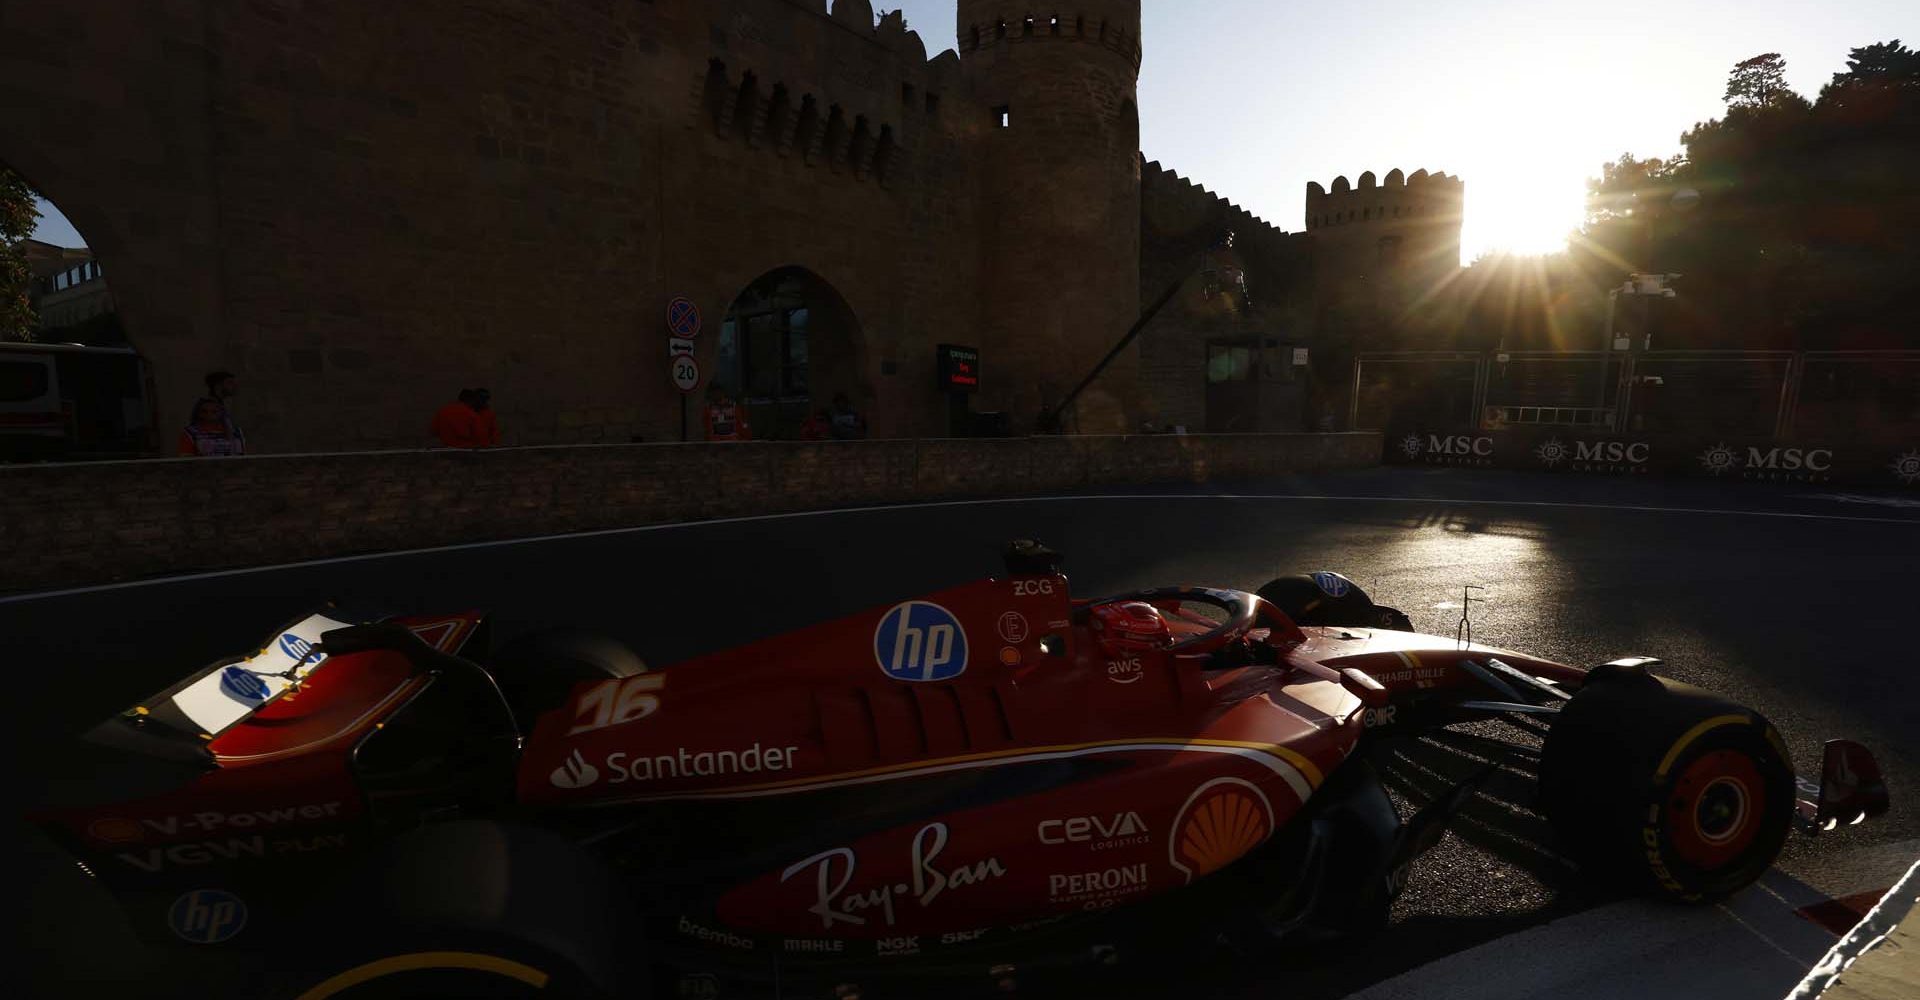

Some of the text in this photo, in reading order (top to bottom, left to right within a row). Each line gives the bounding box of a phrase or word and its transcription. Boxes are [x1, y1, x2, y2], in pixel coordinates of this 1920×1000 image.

[677, 364, 695, 381] 20
[1427, 434, 1493, 456] MSC
[1575, 441, 1649, 463] MSC
[1745, 447, 1832, 471] MSC
[891, 602, 955, 681] hp
[1107, 657, 1142, 675] aws
[1416, 667, 1448, 679] MILLE
[567, 672, 668, 737] 16
[606, 742, 799, 783] Santander
[142, 801, 342, 836] V-Power
[118, 836, 264, 872] VGW
[1048, 863, 1148, 896] PERONI
[184, 890, 236, 942] hp
[679, 914, 754, 950] brembo
[784, 939, 845, 952] MAHLE
[877, 935, 919, 950] NGK
